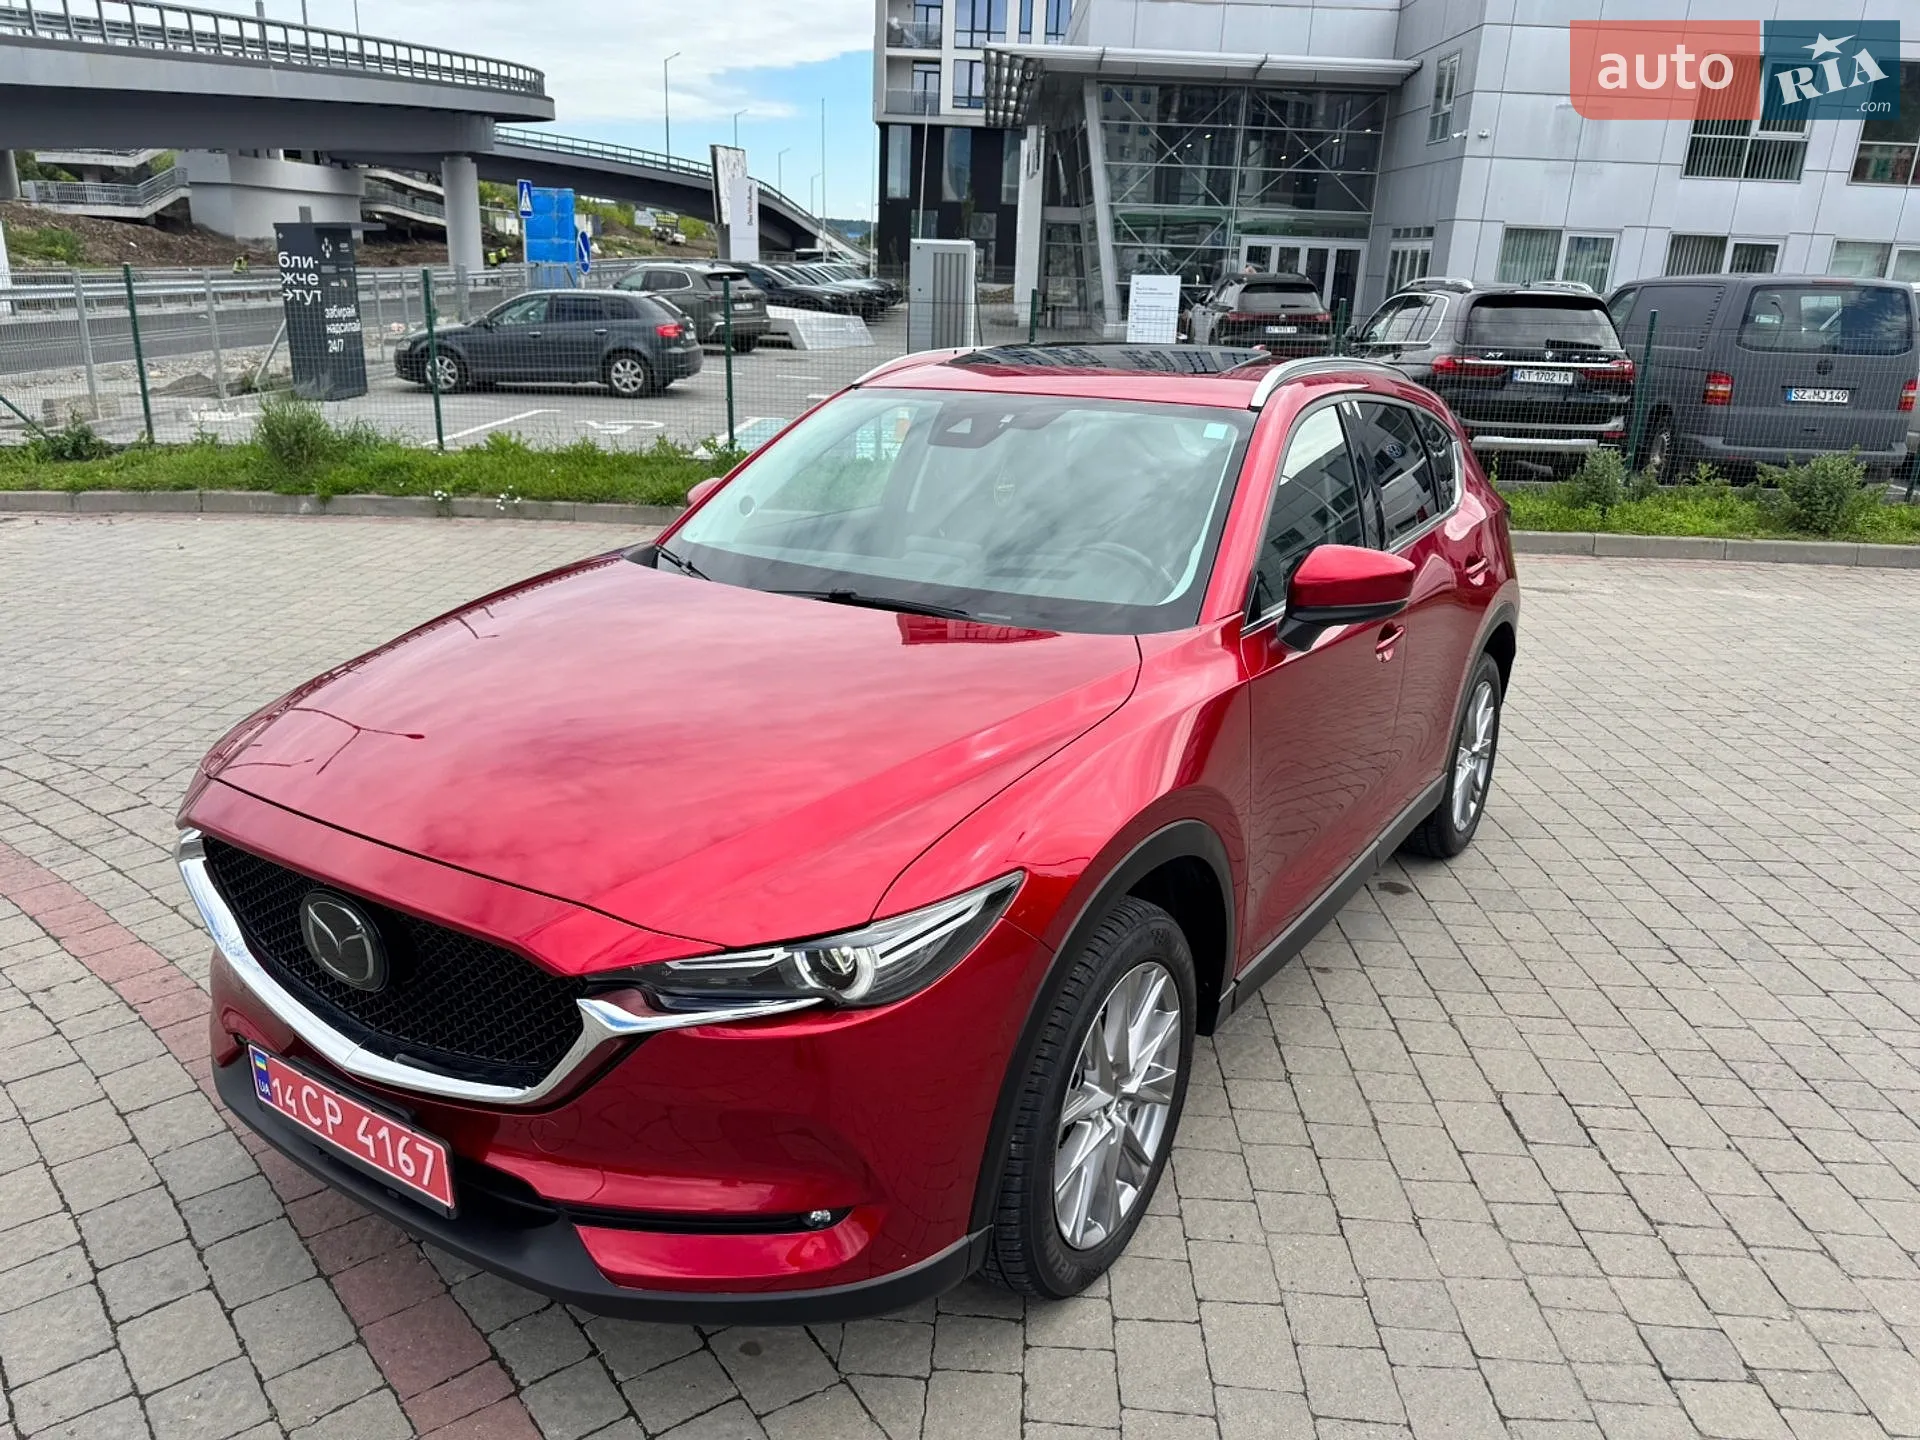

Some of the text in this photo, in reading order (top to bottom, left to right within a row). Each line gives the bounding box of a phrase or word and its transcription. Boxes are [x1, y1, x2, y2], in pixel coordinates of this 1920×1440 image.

[278, 251, 319, 269] бли-
[281, 272, 319, 286] жче
[292, 289, 322, 306] тут
[258, 1078, 271, 1096] UA
[356, 1115, 435, 1187] 4167
